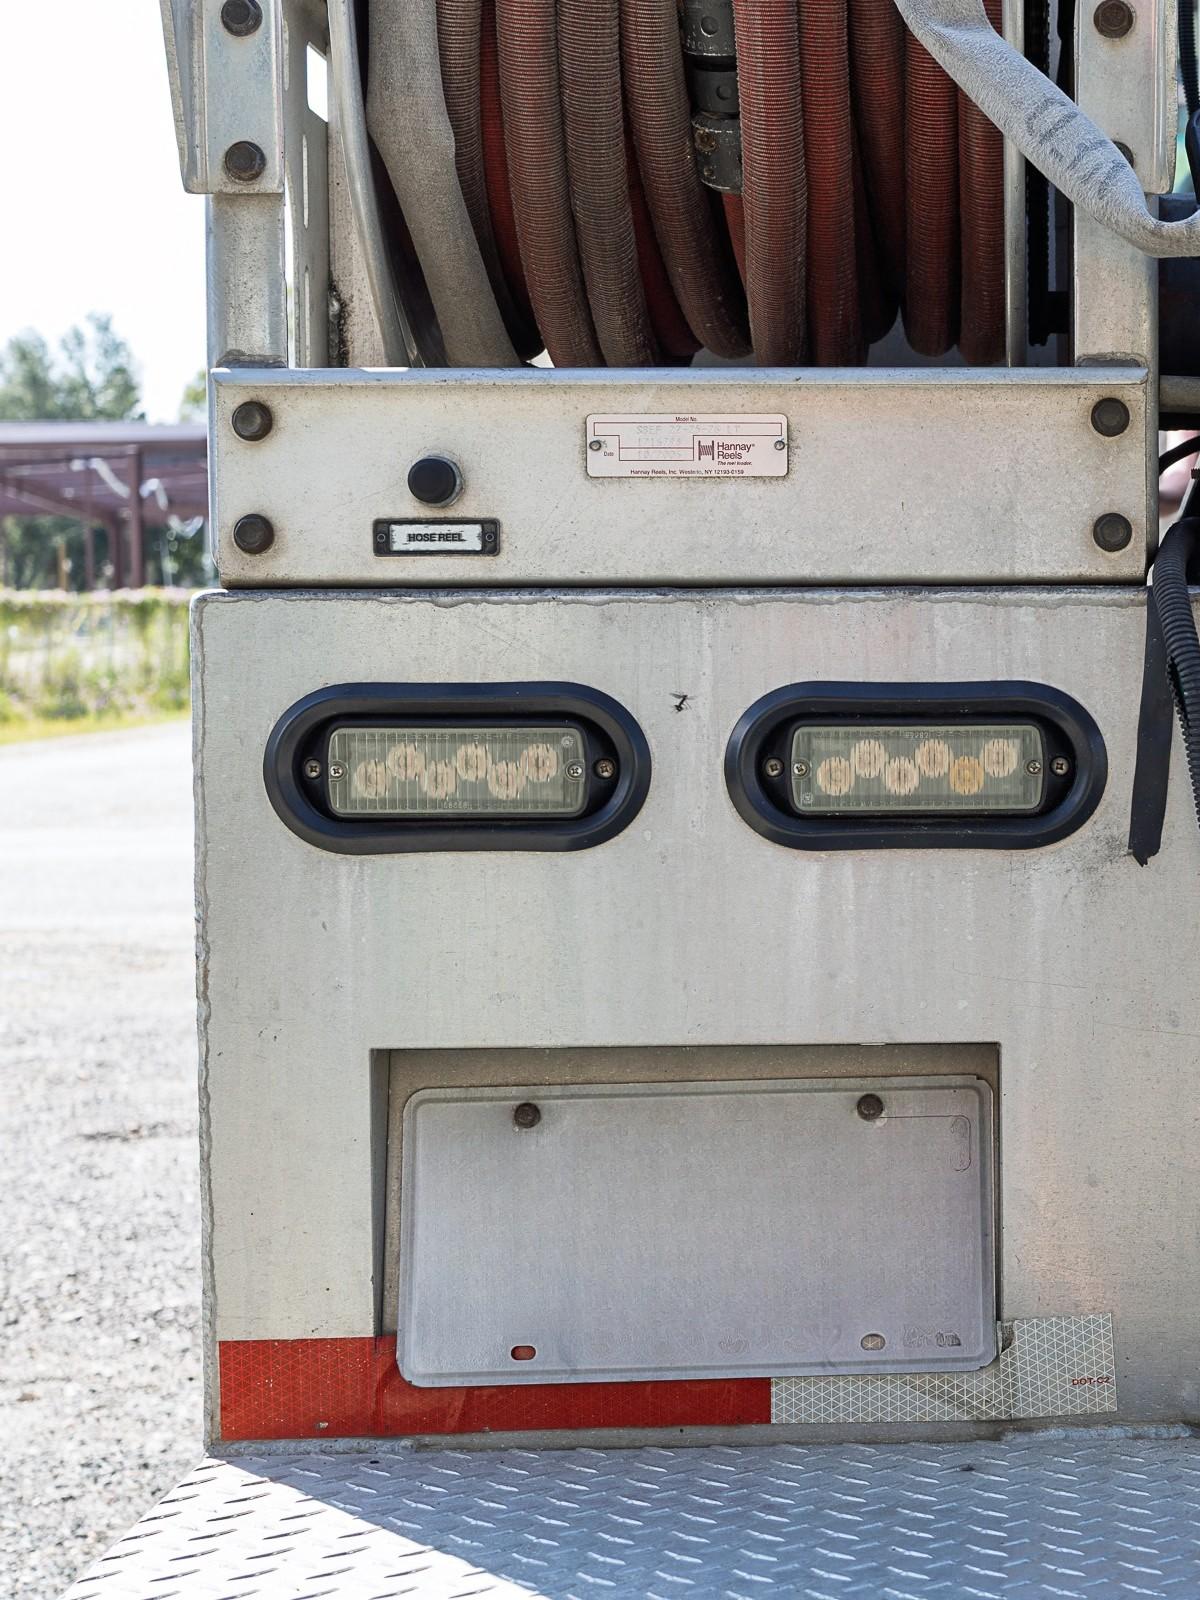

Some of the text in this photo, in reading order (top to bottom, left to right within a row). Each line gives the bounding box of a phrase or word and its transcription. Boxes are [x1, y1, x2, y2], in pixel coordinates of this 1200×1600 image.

[717, 442, 752, 453] Hannay
[717, 451, 742, 459] Reels
[407, 532, 467, 542] HOSE REEL
[1071, 1376, 1110, 1386] DOT-C2
